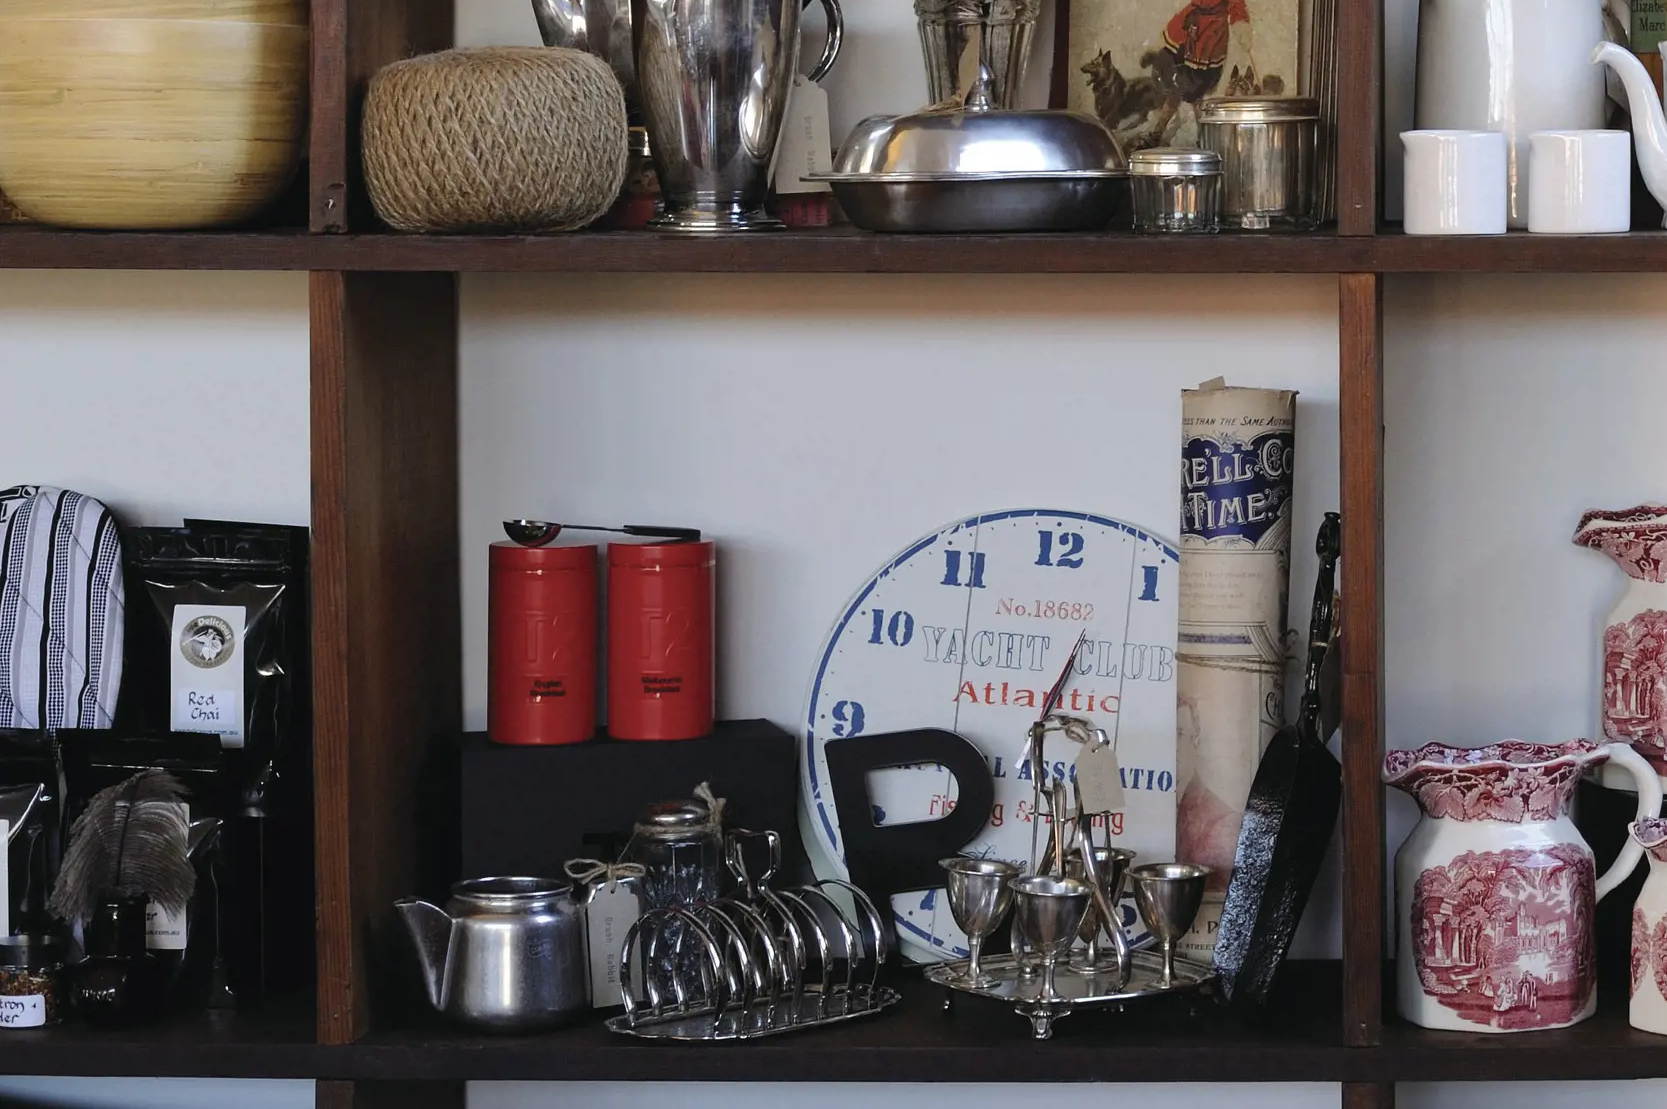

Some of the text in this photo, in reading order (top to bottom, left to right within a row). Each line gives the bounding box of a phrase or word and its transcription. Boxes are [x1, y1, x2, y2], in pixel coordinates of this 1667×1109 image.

[1639, 18, 1666, 31] Marc
[1193, 416, 1216, 426] THAN
[1219, 417, 1237, 426] THE
[1034, 530, 1085, 569] 12
[940, 550, 987, 589] 11
[1138, 565, 1160, 602] 1
[995, 598, 1094, 621] No.18682
[197, 617, 232, 640] Delicious
[868, 608, 914, 647] 10
[922, 626, 1174, 682] YACHT CLUB
[188, 691, 216, 706] Red
[952, 680, 1121, 714] Atlantic
[190, 707, 220, 723] Chai
[832, 700, 866, 738] 9
[928, 794, 1005, 827] Fisg
